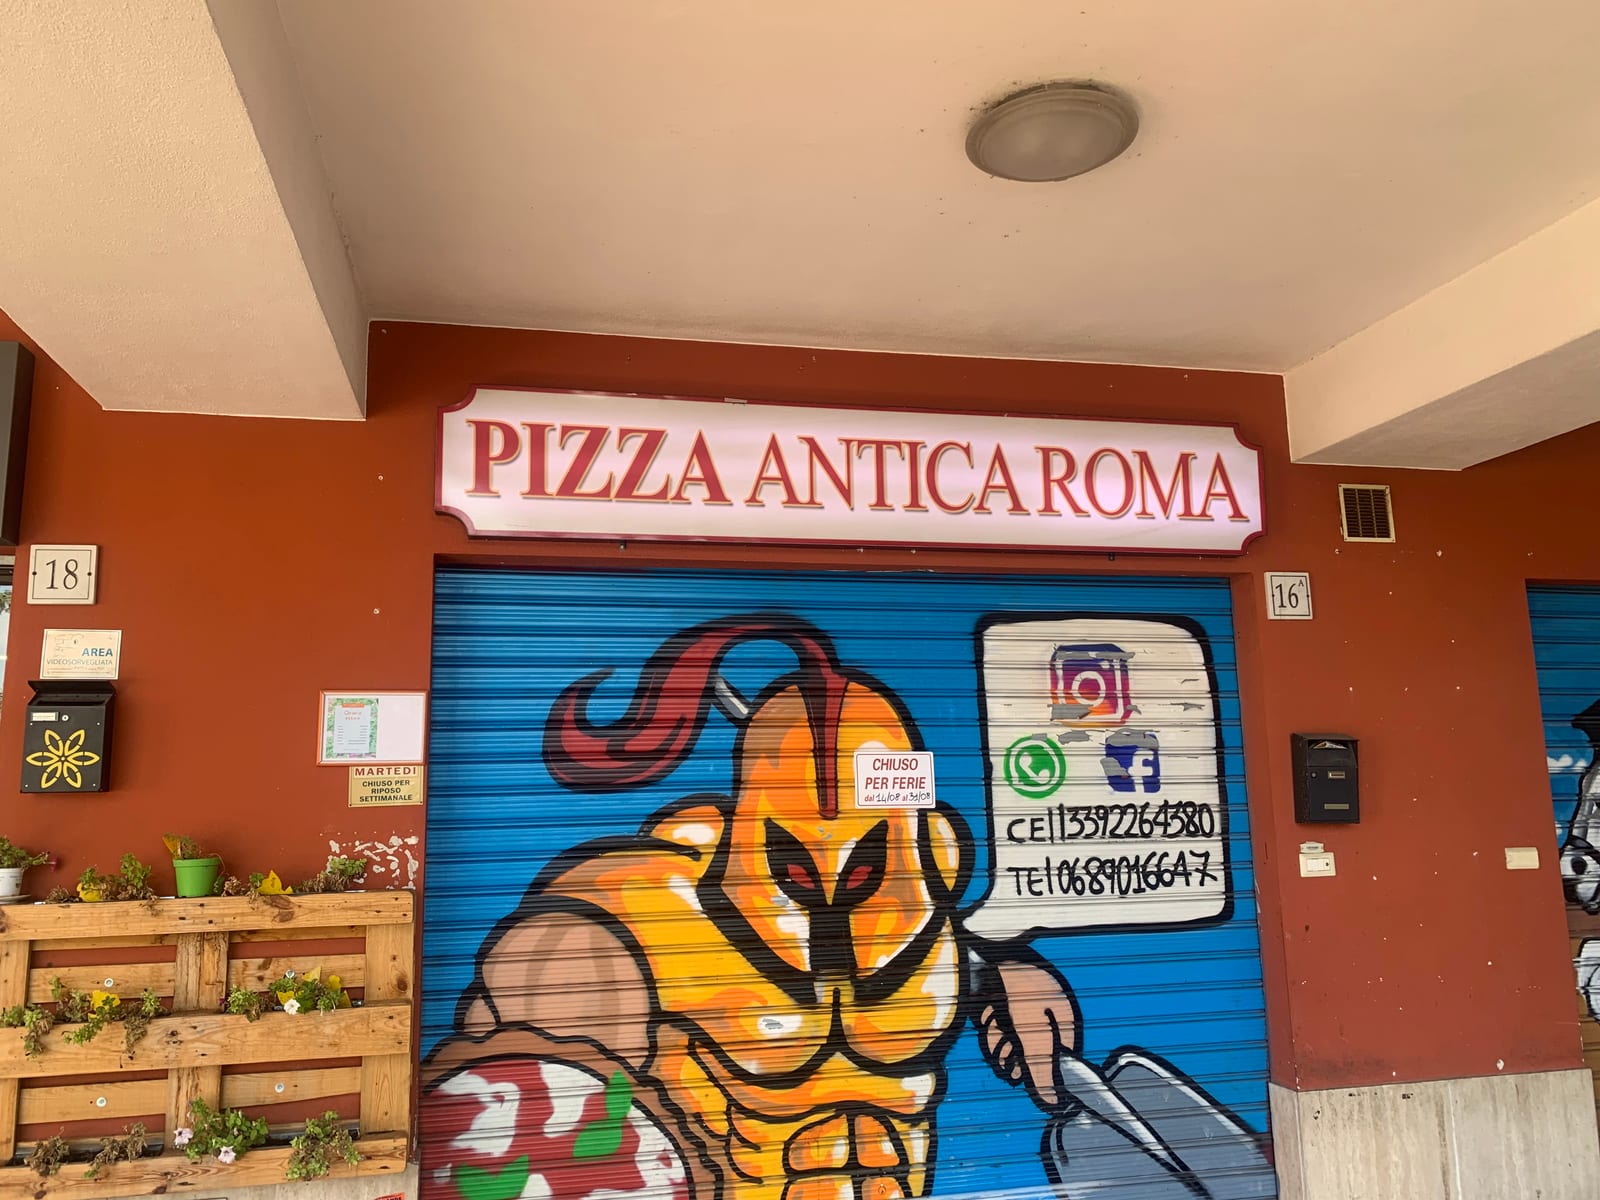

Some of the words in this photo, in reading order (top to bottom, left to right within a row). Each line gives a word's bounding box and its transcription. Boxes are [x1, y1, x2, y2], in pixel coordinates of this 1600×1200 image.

[465, 418, 734, 506] PIZZA
[743, 432, 1031, 516] ANTICA
[1034, 444, 1251, 522] ROMA
[45, 558, 79, 590] 18
[81, 647, 114, 658] AREA
[47, 658, 113, 666] VIDEOSORVEGLIATA
[872, 758, 919, 771] CHIUSO
[354, 766, 417, 777] MARTEDI
[362, 780, 393, 788] CHIUSO
[394, 779, 411, 787] PER
[864, 776, 889, 790] PER
[892, 776, 927, 790] FERIE
[371, 787, 402, 795] RIPOSO
[359, 794, 413, 803] SETTIMANALE
[864, 794, 875, 802] dal
[901, 794, 908, 802] al
